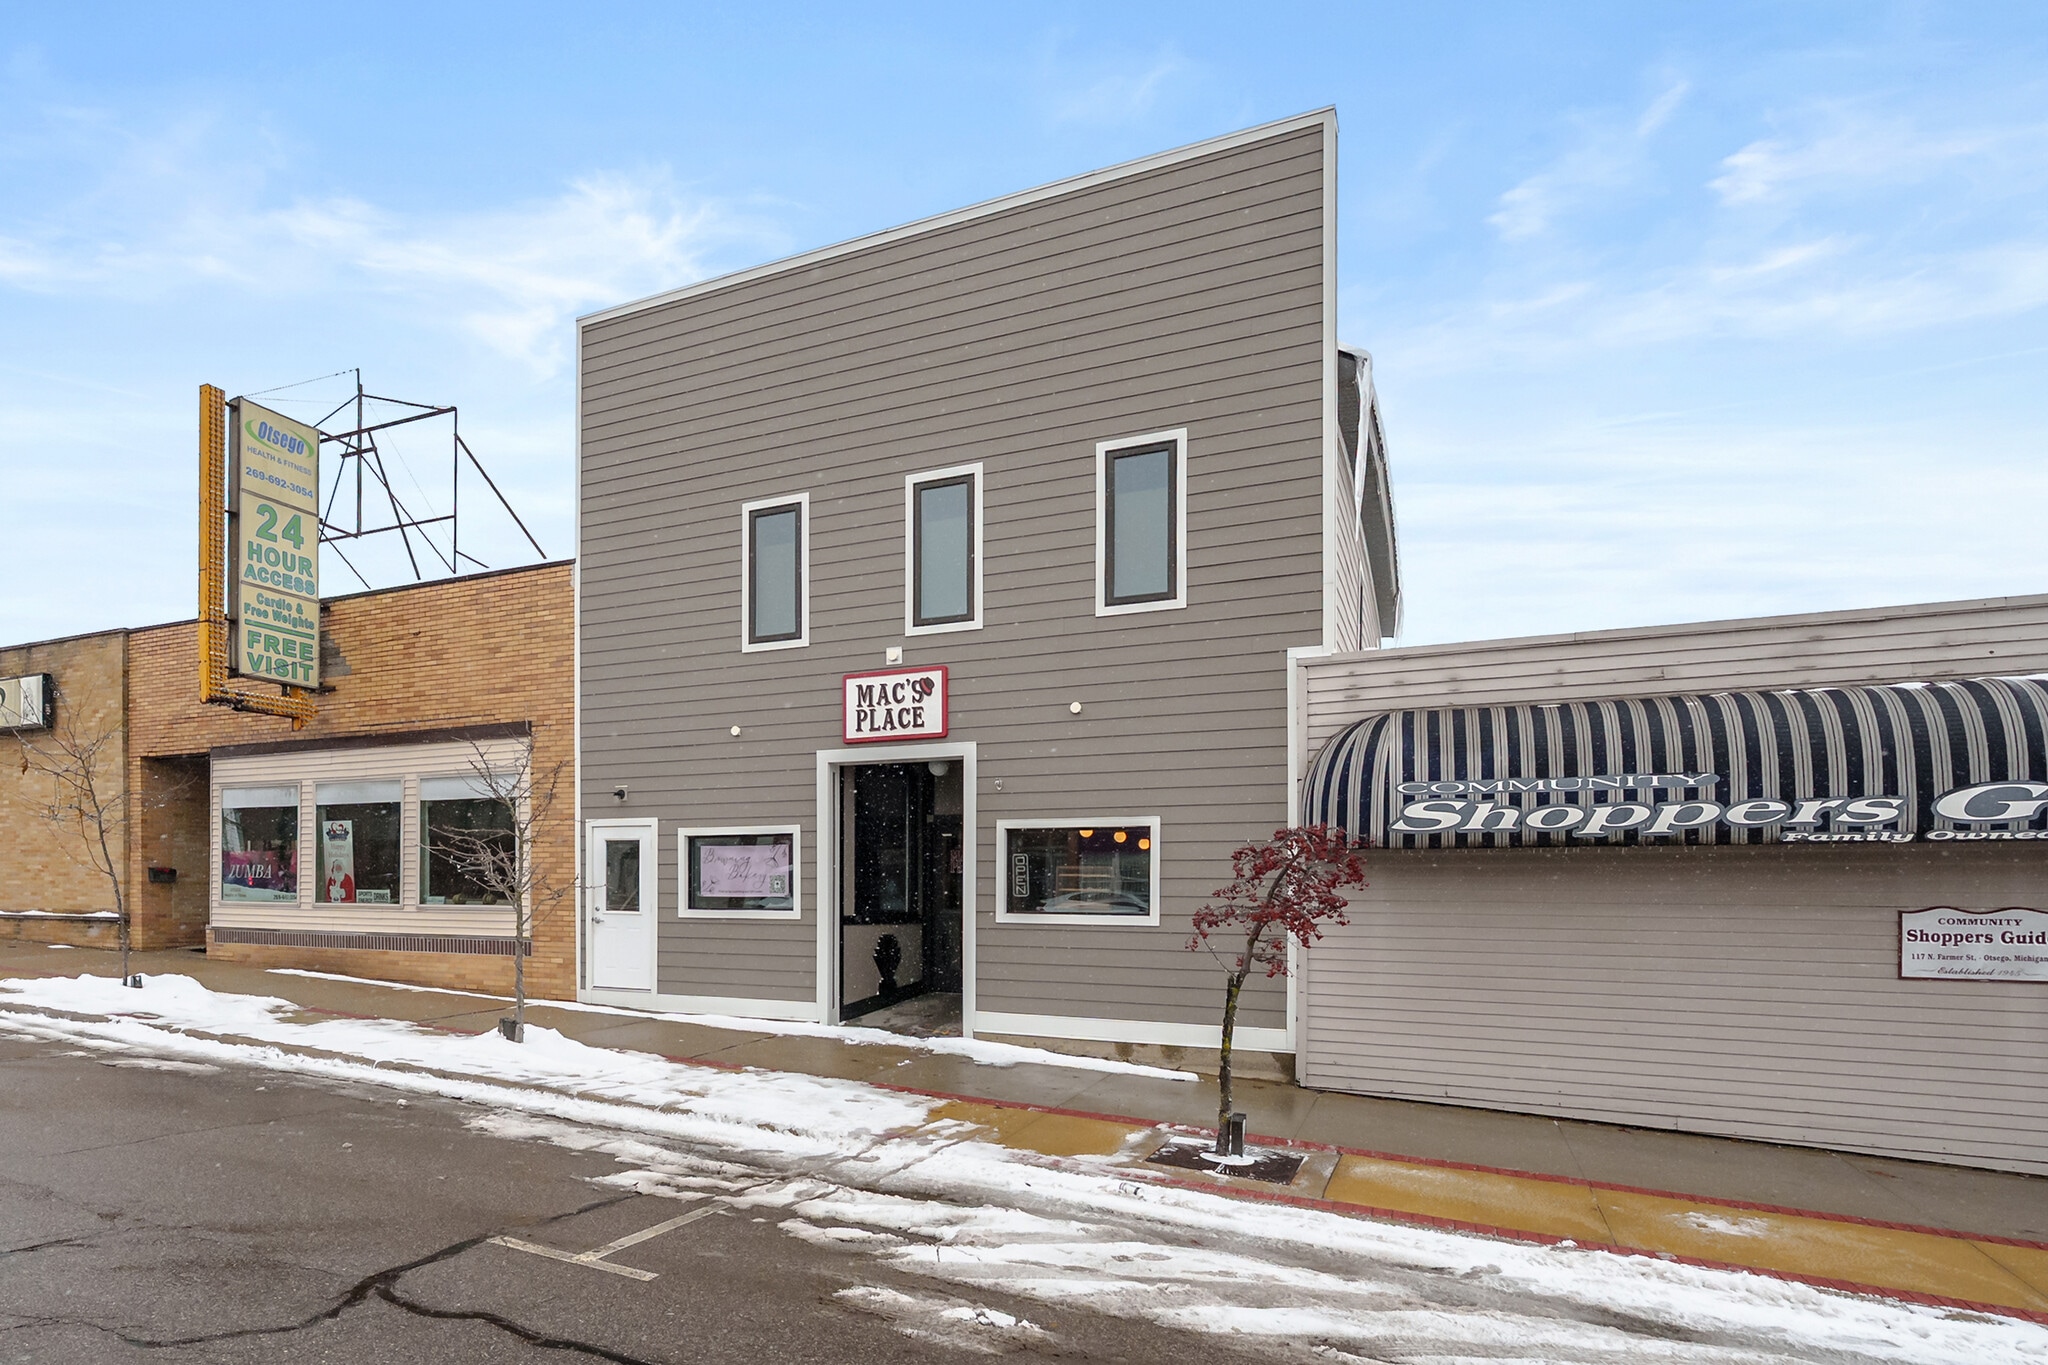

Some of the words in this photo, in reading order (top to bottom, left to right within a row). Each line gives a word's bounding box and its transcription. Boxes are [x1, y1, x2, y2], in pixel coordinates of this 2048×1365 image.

[258, 421, 305, 455] Otsego
[246, 445, 276, 462] HEALTH
[276, 457, 283, 465] &
[283, 460, 312, 476] FITNESS
[245, 466, 314, 499] 269-692-3054
[256, 503, 304, 550] 24
[247, 540, 313, 578] HOUR
[244, 563, 316, 596] ACCESS
[244, 602, 269, 619] Free
[272, 608, 315, 630] Weights
[256, 592, 293, 612] Cardio
[295, 602, 304, 615] &
[247, 629, 314, 662] FREE
[246, 651, 314, 682] VISIT
[855, 678, 925, 708] MAC'S
[855, 706, 925, 733] PLACE
[1395, 772, 1713, 794] COMMUNITY
[1390, 798, 1905, 835] Shoppers
[1782, 830, 1918, 843] Family
[229, 863, 272, 879] ZUMBA
[1015, 856, 1026, 894] OPEN
[373, 892, 389, 901] DRINKS
[1937, 917, 2023, 926] COMMUNITY
[1906, 929, 1994, 947] Shoppers
[2000, 930, 2048, 945] Guid
[1937, 953, 1963, 961] Farmer
[2014, 954, 2048, 964] Michigan
[1937, 966, 1996, 976] Established
